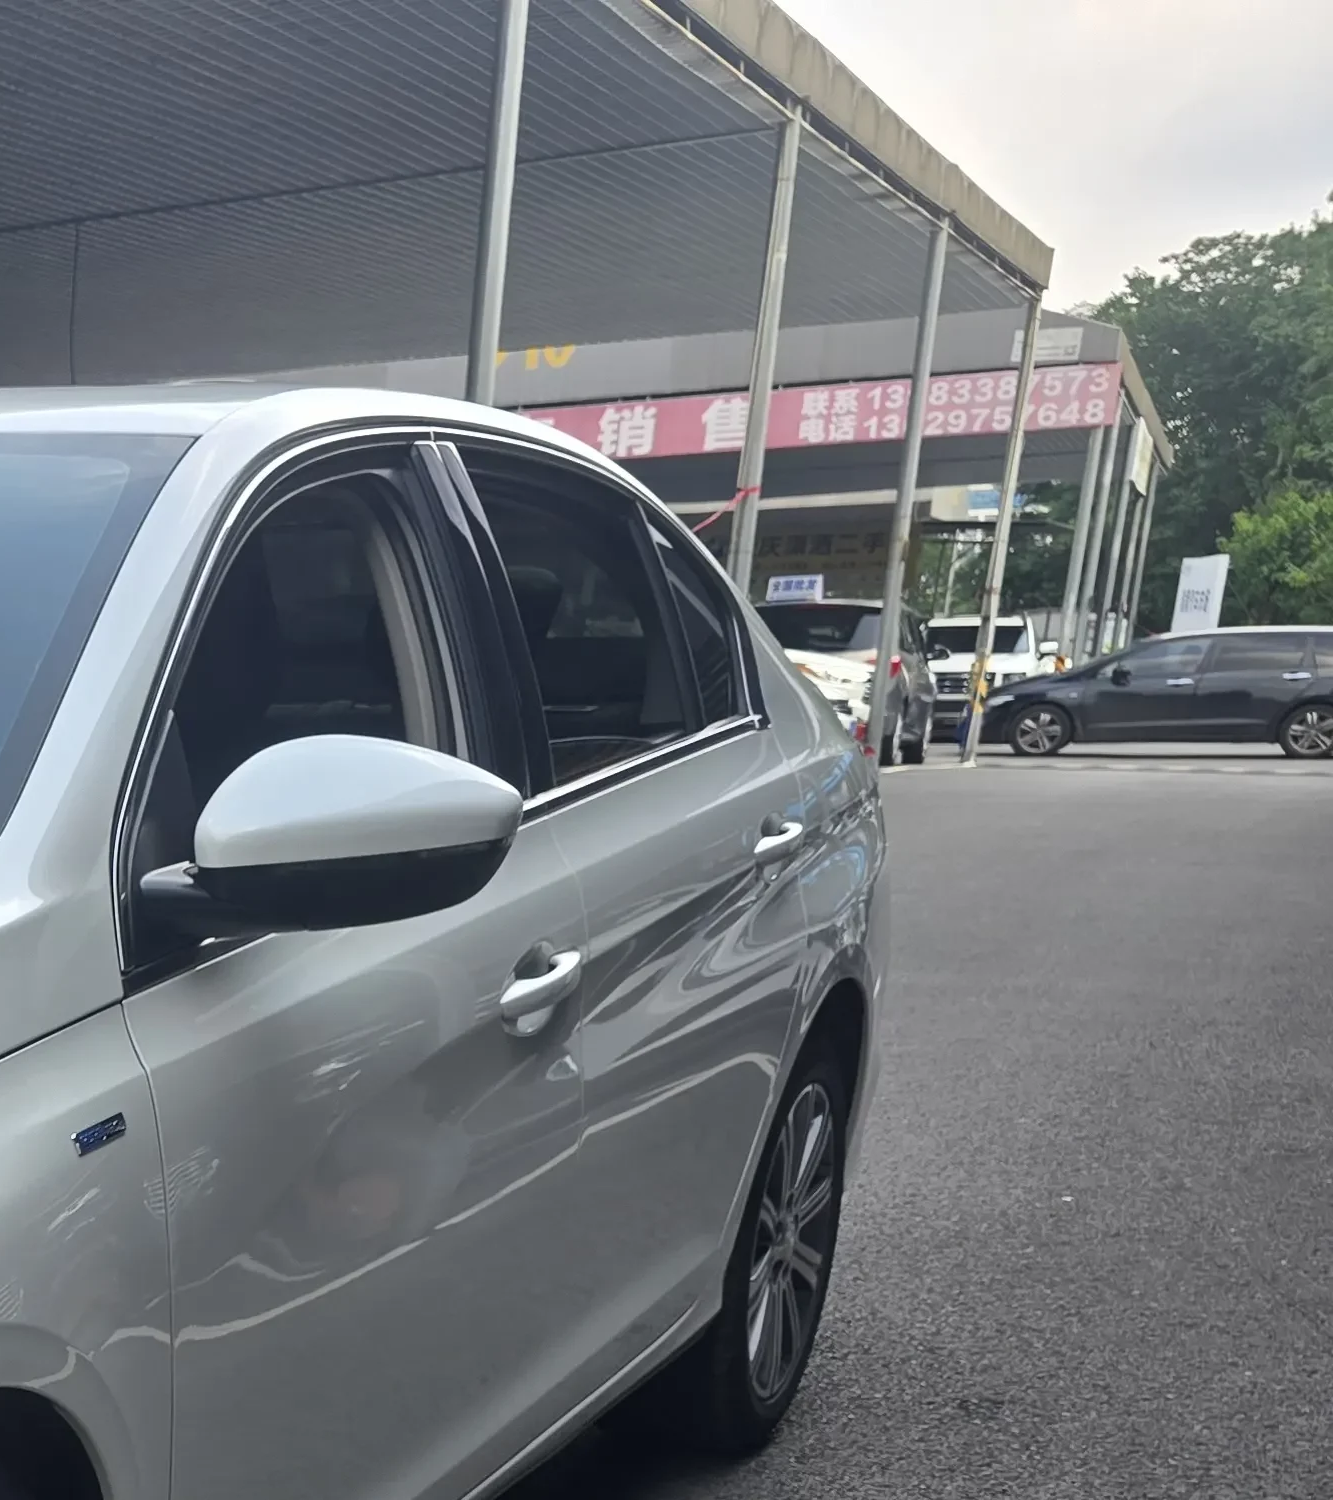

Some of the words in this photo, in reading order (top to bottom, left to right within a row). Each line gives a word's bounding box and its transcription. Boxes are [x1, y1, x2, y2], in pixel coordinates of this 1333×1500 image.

[801, 388, 859, 417] 联系
[867, 367, 1110, 409] 1383387573
[798, 414, 857, 443] 电话
[863, 399, 1105, 439] 132975648
